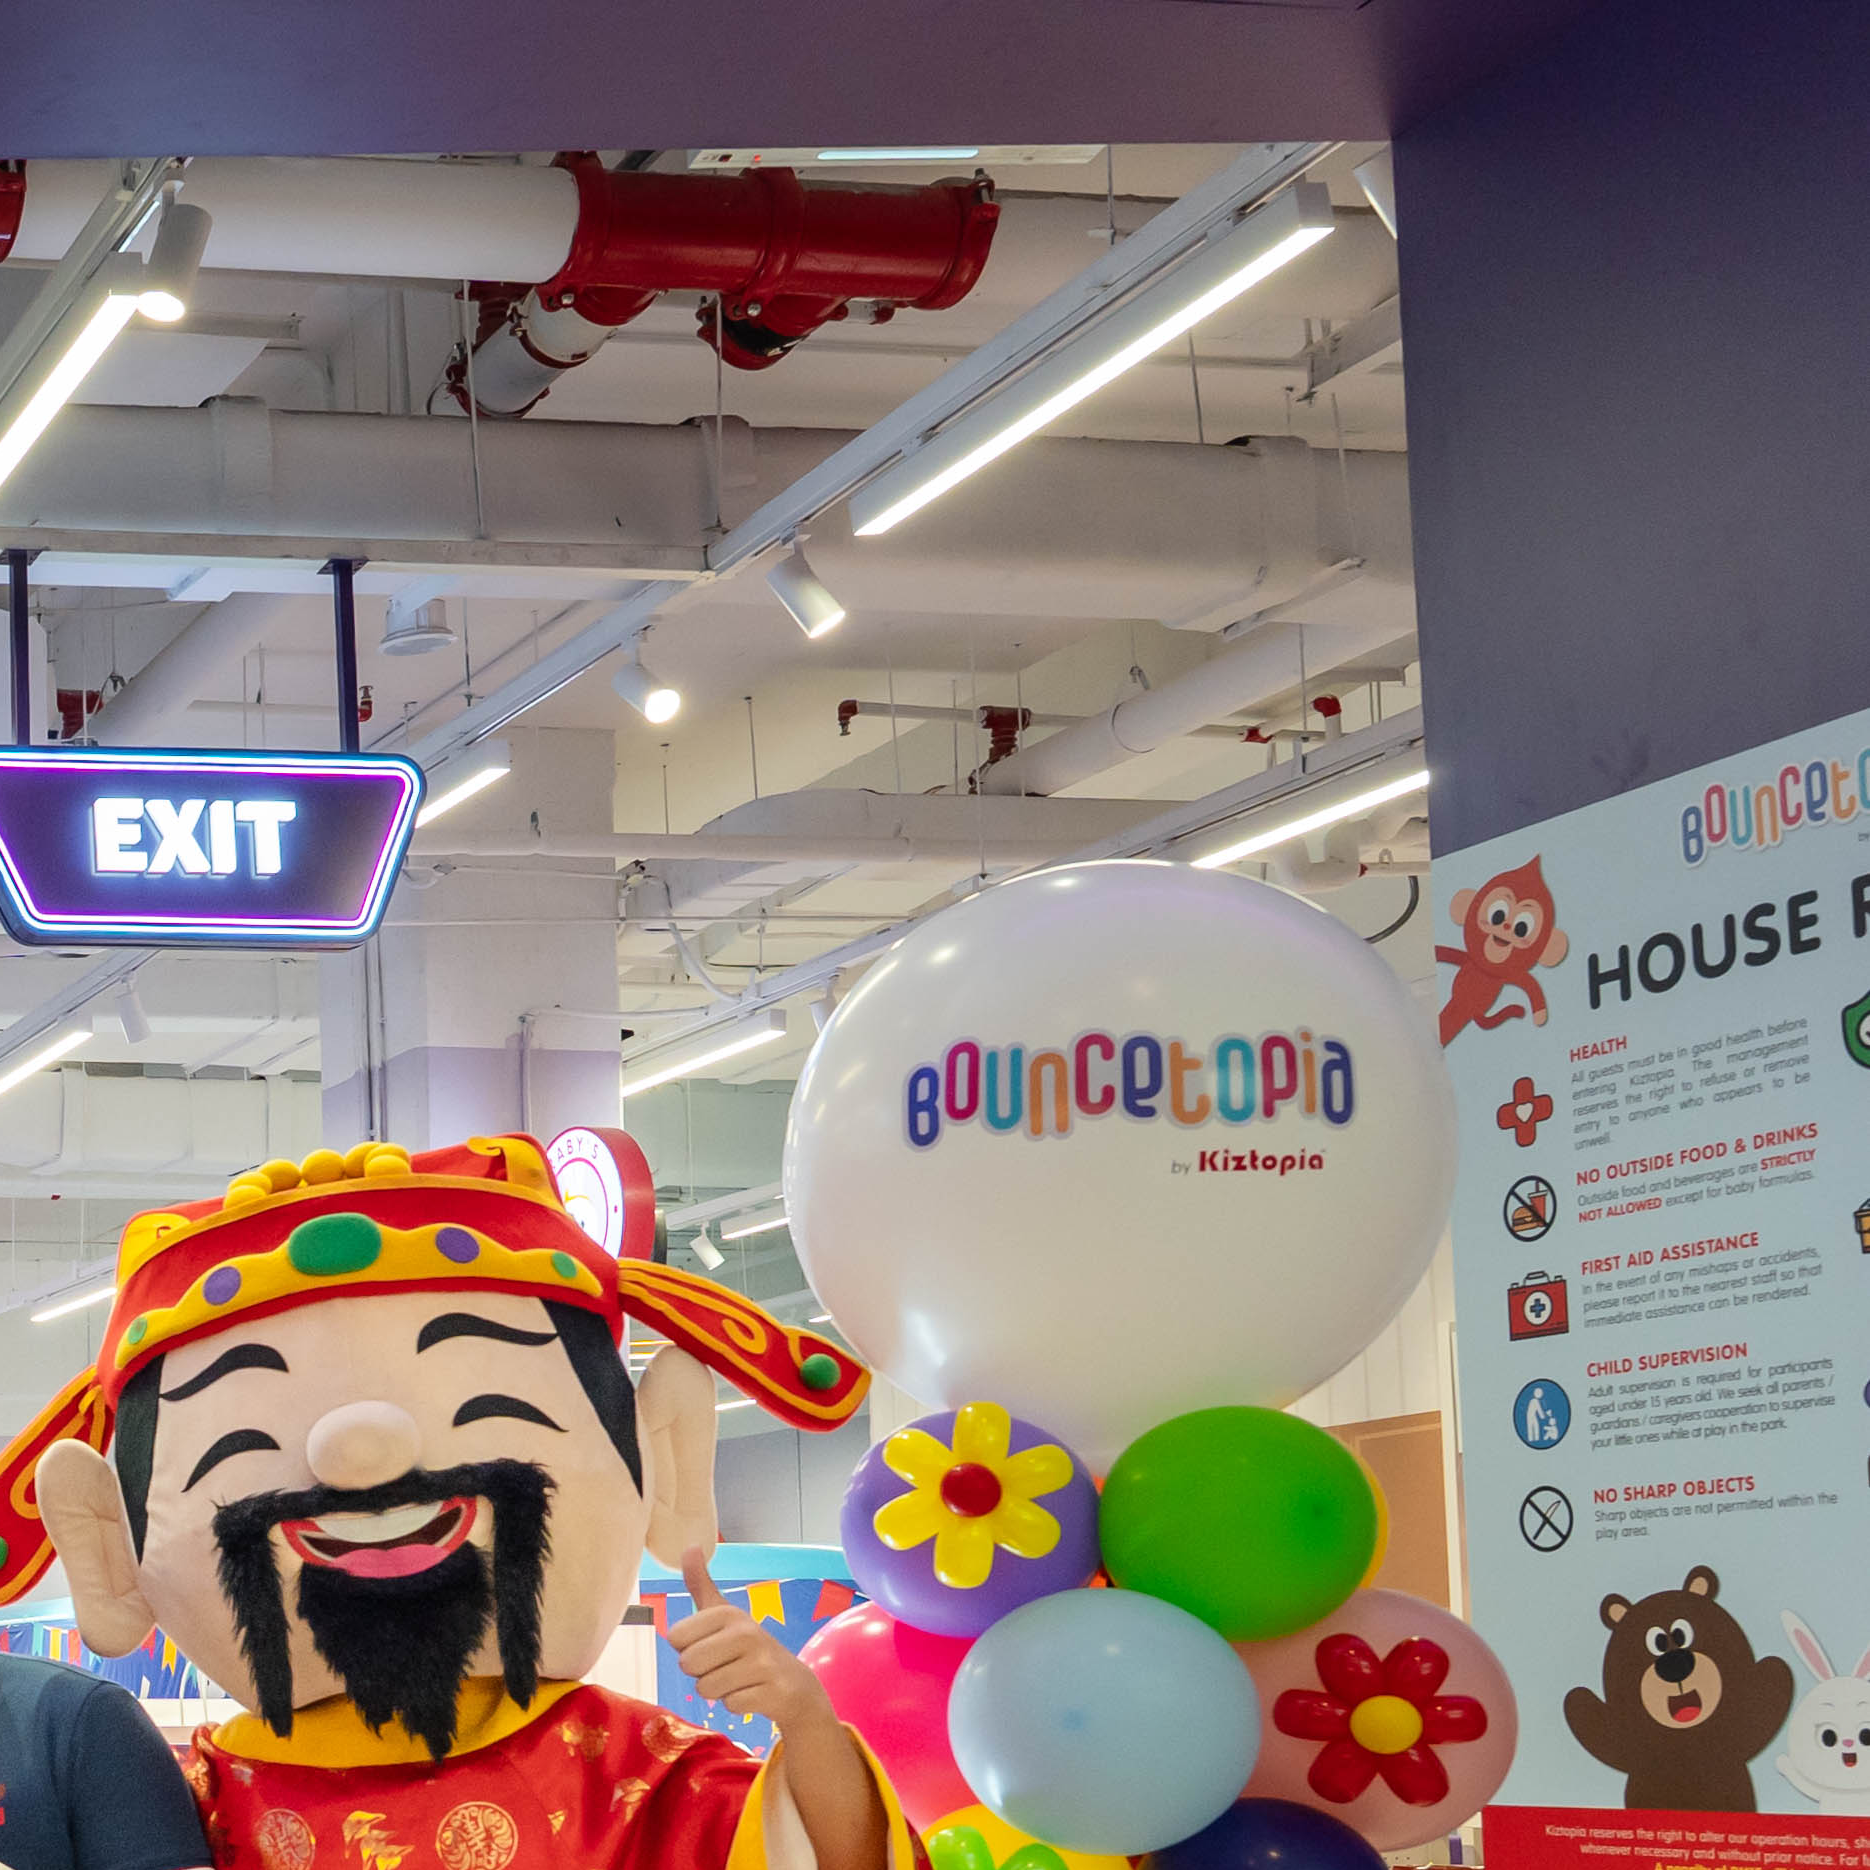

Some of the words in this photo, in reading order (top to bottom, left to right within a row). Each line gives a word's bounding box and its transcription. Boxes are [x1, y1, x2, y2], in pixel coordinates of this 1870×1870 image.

[93, 797, 297, 874] EXIT
[1587, 890, 1821, 1010] HOUSE
[1570, 1036, 1627, 1062] HEALTH
[1572, 1069, 1584, 1083] All
[1589, 1061, 1623, 1082] guests
[1628, 1052, 1654, 1070] must
[1659, 1050, 1673, 1062] be
[1678, 1047, 1687, 1058] in
[1692, 1036, 1721, 1057] good
[1727, 1026, 1763, 1046] health
[1768, 1019, 1807, 1036] before
[1171, 1160, 1191, 1175] by
[1198, 1149, 1324, 1176] Kiztopia
[1577, 1167, 1599, 1185] NO
[1607, 1152, 1674, 1179] OUTSIDE
[1681, 1142, 1727, 1164] FOOD
[1734, 1138, 1746, 1154] &
[1754, 1124, 1818, 1150] DRINKS
[1578, 1189, 1619, 1206] Outside
[1622, 1182, 1646, 1198] food
[1649, 1178, 1671, 1193] and
[1674, 1168, 1734, 1188] beverages
[1739, 1164, 1758, 1176] are
[1761, 1150, 1816, 1171] STRICTLY
[1579, 1208, 1602, 1223] NOT
[1606, 1196, 1662, 1218] ALLOWED
[1666, 1188, 1703, 1206] except
[1707, 1186, 1722, 1198] for
[1726, 1179, 1755, 1195] baby
[1582, 1255, 1621, 1276] FIRST
[1627, 1249, 1653, 1268] AID
[1660, 1232, 1759, 1263] ASSISTANCE
[1583, 1283, 1592, 1295] In
[1596, 1280, 1612, 1293] the
[1617, 1274, 1645, 1289] event
[1650, 1271, 1661, 1284] of
[1664, 1270, 1684, 1283] any
[1689, 1262, 1738, 1278] mishaps
[1743, 1259, 1755, 1270] or
[1583, 1297, 1619, 1314] please
[1623, 1289, 1655, 1306] report
[1659, 1287, 1664, 1299] it
[1668, 1286, 1679, 1298] to
[1682, 1283, 1700, 1296] the
[1704, 1275, 1748, 1292] nearest
[1751, 1270, 1777, 1285] staff
[1780, 1270, 1795, 1281] so
[1799, 1264, 1822, 1278] that
[1584, 1310, 1642, 1328] immediate
[1646, 1302, 1704, 1319] assistance
[1709, 1299, 1729, 1310] can
[1734, 1295, 1748, 1307] be
[1587, 1357, 1632, 1377] CHILD
[1639, 1343, 1747, 1371] SUPERVISION
[1588, 1383, 1613, 1398] Adult
[1619, 1378, 1675, 1396] supervision
[1682, 1376, 1690, 1386] is
[1696, 1368, 1740, 1386] required
[1747, 1367, 1761, 1379] for
[1768, 1358, 1832, 1379] participants
[1594, 1488, 1617, 1504] NO
[1624, 1482, 1676, 1501] SHARP
[1683, 1476, 1755, 1496] OBJECTS
[1595, 1509, 1626, 1523] Sharp
[1630, 1505, 1668, 1522] objects
[1672, 1506, 1691, 1516] are
[1695, 1502, 1712, 1515] not
[1717, 1497, 1773, 1516] permitted
[1778, 1495, 1814, 1509] within
[1818, 1493, 1838, 1506] the
[1596, 1527, 1618, 1542] play
